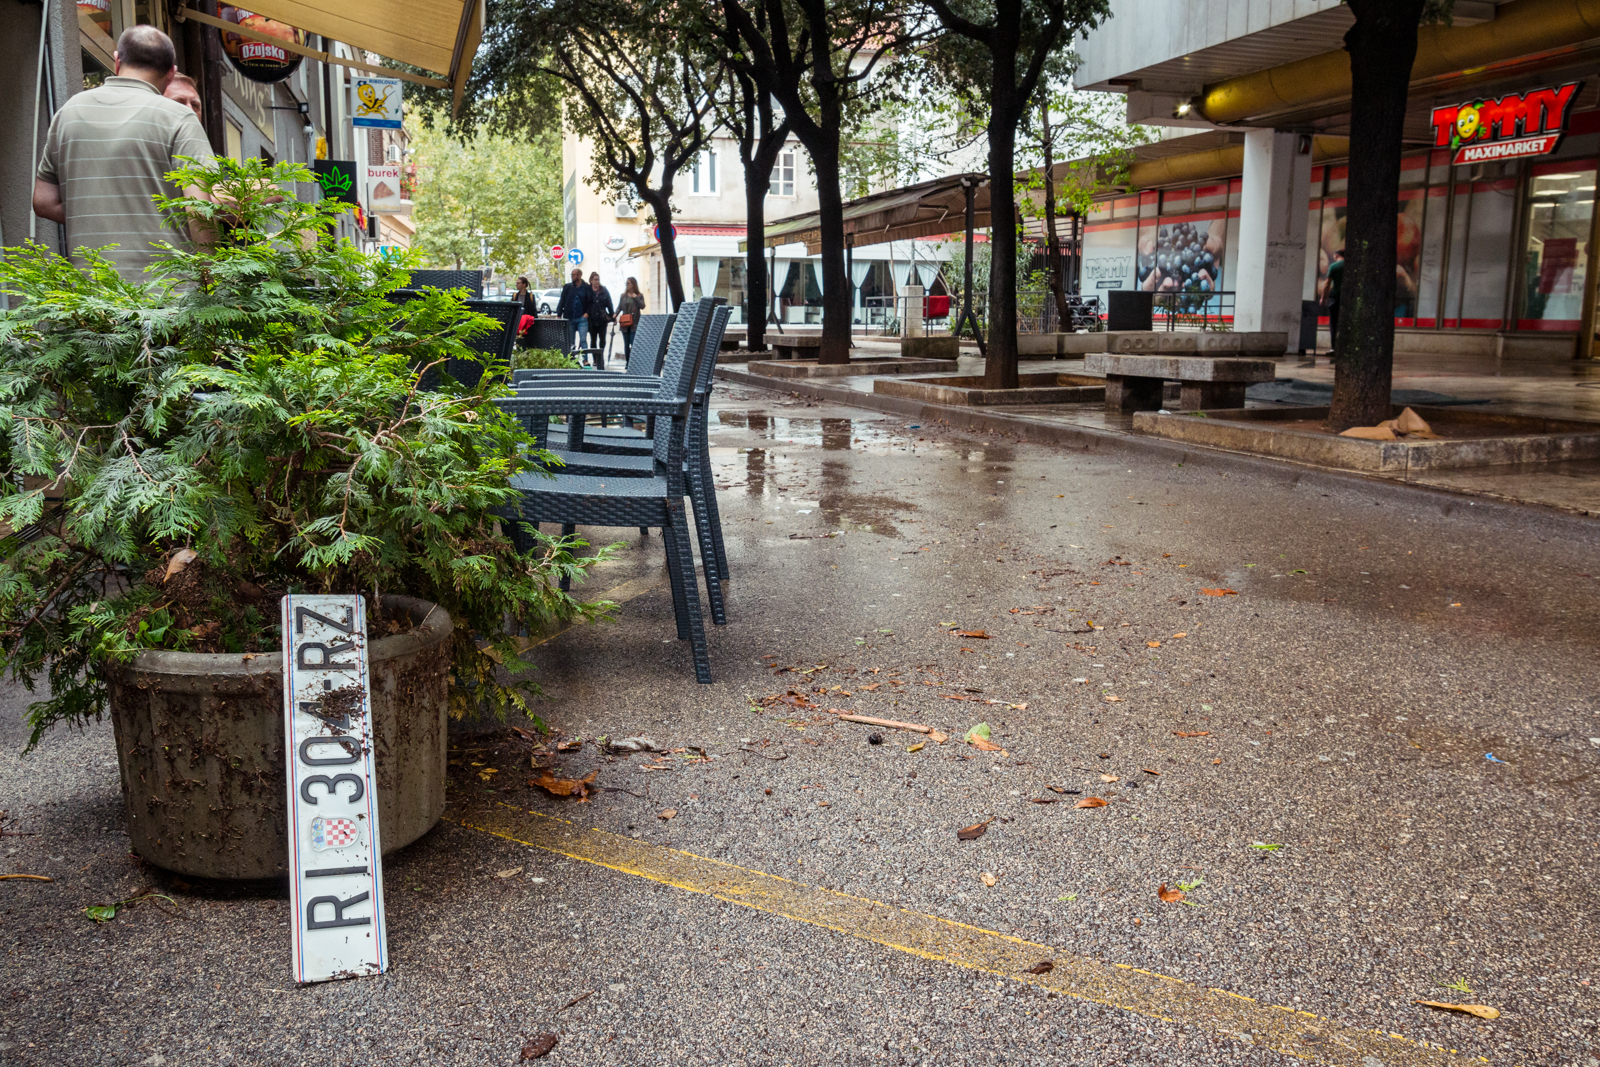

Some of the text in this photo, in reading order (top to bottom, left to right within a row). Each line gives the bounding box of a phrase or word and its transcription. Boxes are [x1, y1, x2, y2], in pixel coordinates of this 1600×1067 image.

[242, 43, 285, 60] Ožujsko
[1432, 82, 1577, 147] TOMMY
[1464, 139, 1548, 161] MAXIMARKET
[368, 168, 399, 178] burek
[1086, 256, 1131, 279] TOMMY
[304, 865, 371, 931] RI
